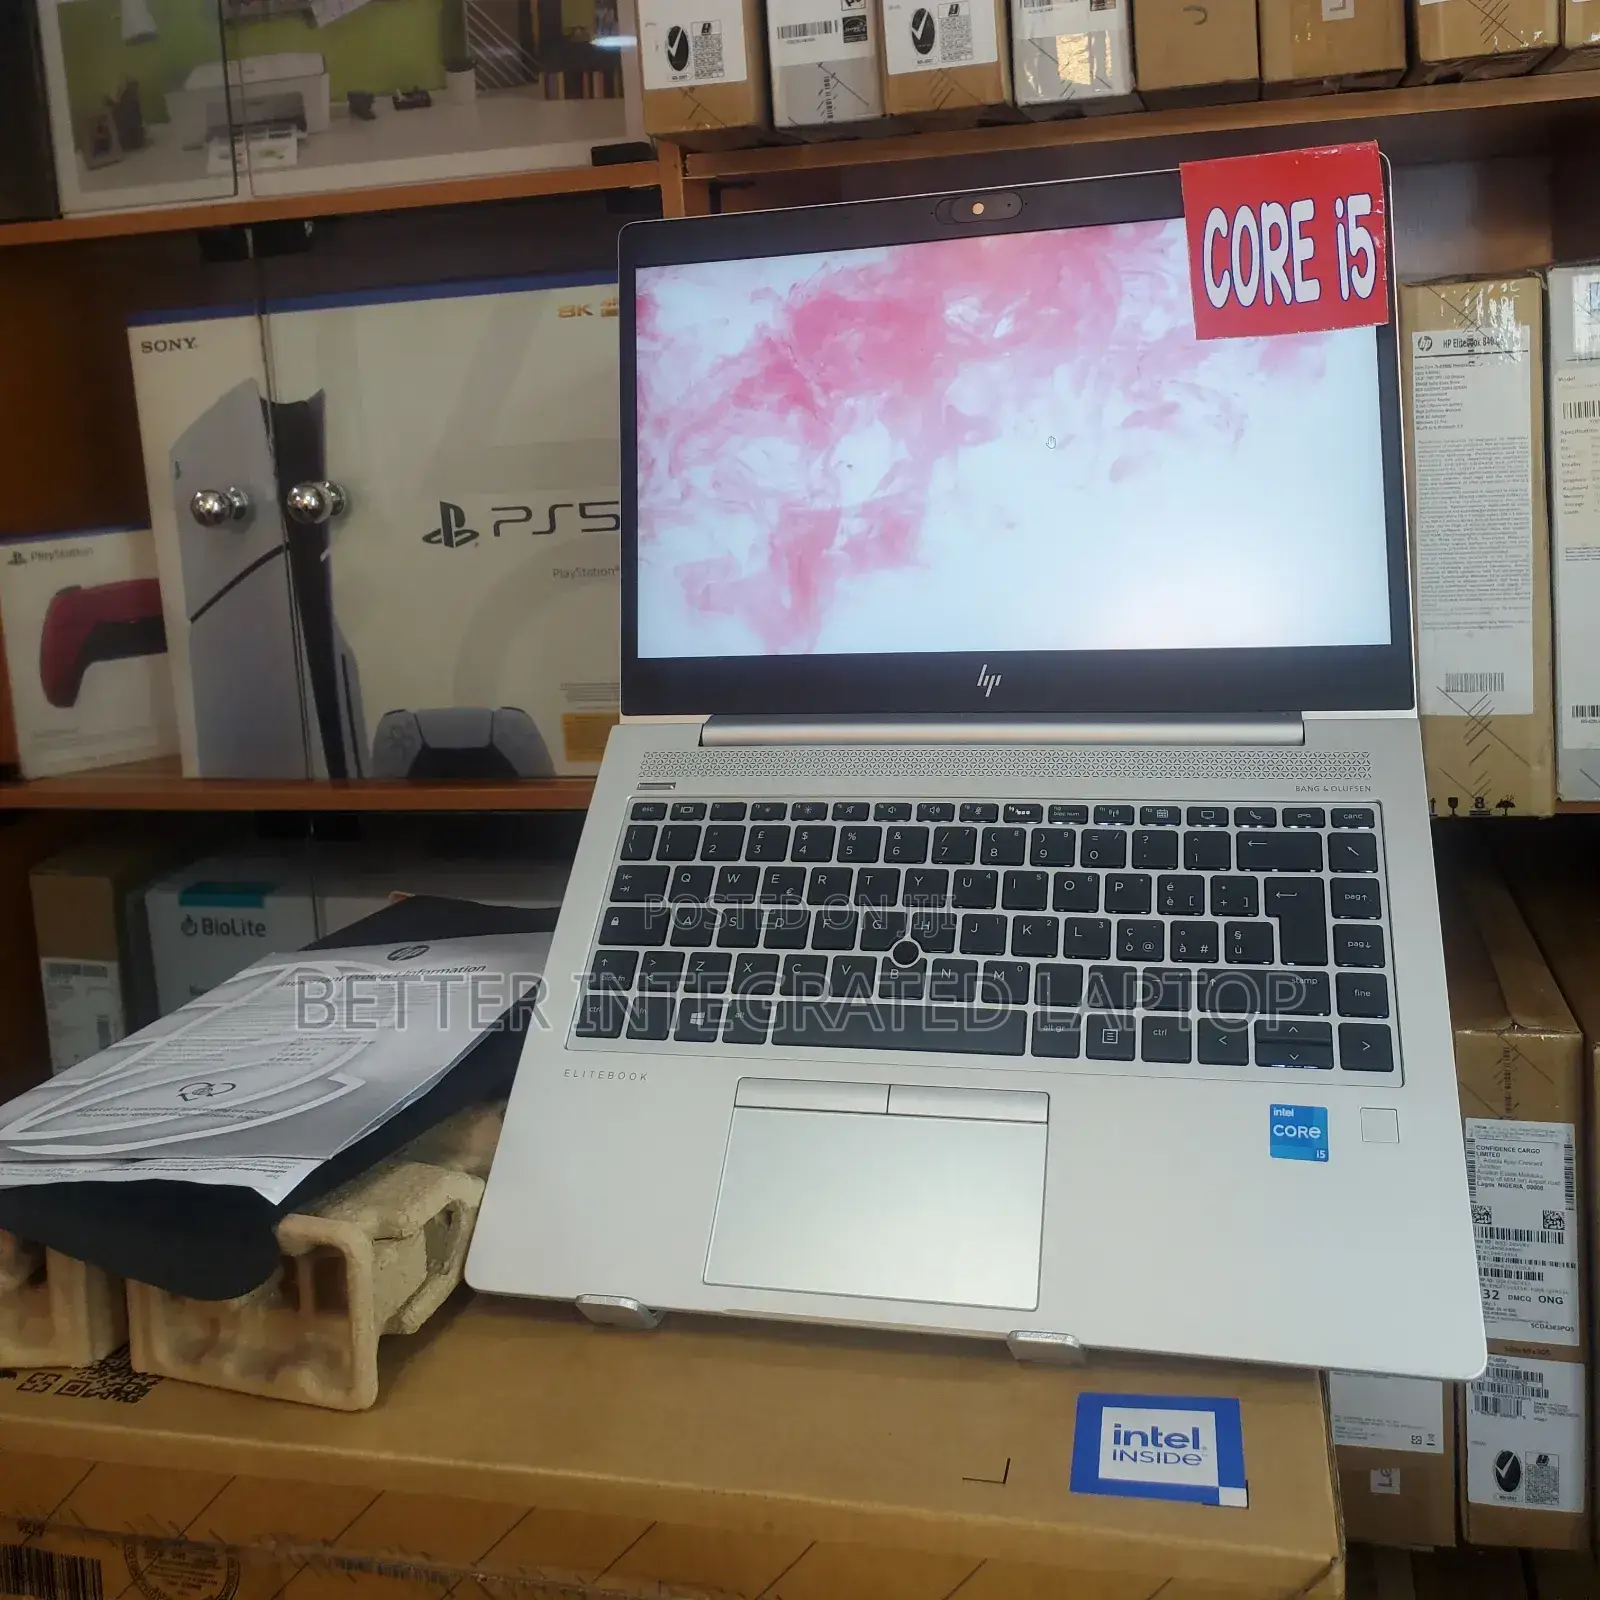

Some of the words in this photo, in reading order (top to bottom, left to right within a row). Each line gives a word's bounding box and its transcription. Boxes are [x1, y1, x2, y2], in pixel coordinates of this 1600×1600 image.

[1202, 198, 1322, 308] CORE
[1335, 192, 1377, 301] i5
[141, 336, 196, 354] SONY
[1443, 339, 1451, 349] HP
[491, 500, 620, 537] PS5
[802, 832, 808, 840] $
[848, 832, 856, 840] %
[666, 845, 669, 853] 1
[709, 845, 716, 853] 2
[754, 845, 761, 853] 3
[799, 845, 806, 854] 4
[846, 846, 852, 854] 5
[893, 846, 900, 855] 6
[942, 847, 948, 855] 7
[991, 848, 997, 857] 8
[1040, 849, 1047, 858] 9
[681, 873, 691, 883] Q
[727, 874, 741, 883] W
[772, 874, 780, 883] E
[818, 875, 827, 884] R
[865, 876, 874, 885] T
[915, 877, 923, 886] Y
[963, 878, 972, 887] U
[1064, 881, 1075, 890] O
[1115, 882, 1123, 891] P
[1167, 882, 1174, 891] é
[1167, 897, 1174, 905] è
[1344, 893, 1361, 902] pag
[202, 916, 267, 938] BioLite
[971, 923, 978, 933] J
[1023, 925, 1032, 935] K
[1075, 927, 1082, 937] L
[1126, 942, 1133, 951] ò
[1143, 942, 1154, 952] @
[1180, 944, 1186, 953] à
[1200, 945, 1208, 953] #
[1348, 940, 1365, 949] pag
[695, 961, 705, 972] Z
[743, 962, 753, 973] X
[792, 964, 802, 974] C
[841, 965, 851, 975] V
[890, 969, 899, 979] B
[941, 969, 951, 979] N
[993, 970, 1005, 981] M
[1354, 988, 1372, 998] fine
[1152, 1028, 1167, 1036] ctrl
[564, 1068, 648, 1081] ELITEBOOK
[1273, 1108, 1295, 1118] intel
[1316, 1149, 1326, 1159] i5
[1476, 1144, 1516, 1153] CONFIDENCE
[1517, 1147, 1541, 1155] CARGO
[1538, 1295, 1564, 1305] ONG
[1113, 1423, 1200, 1450] intel
